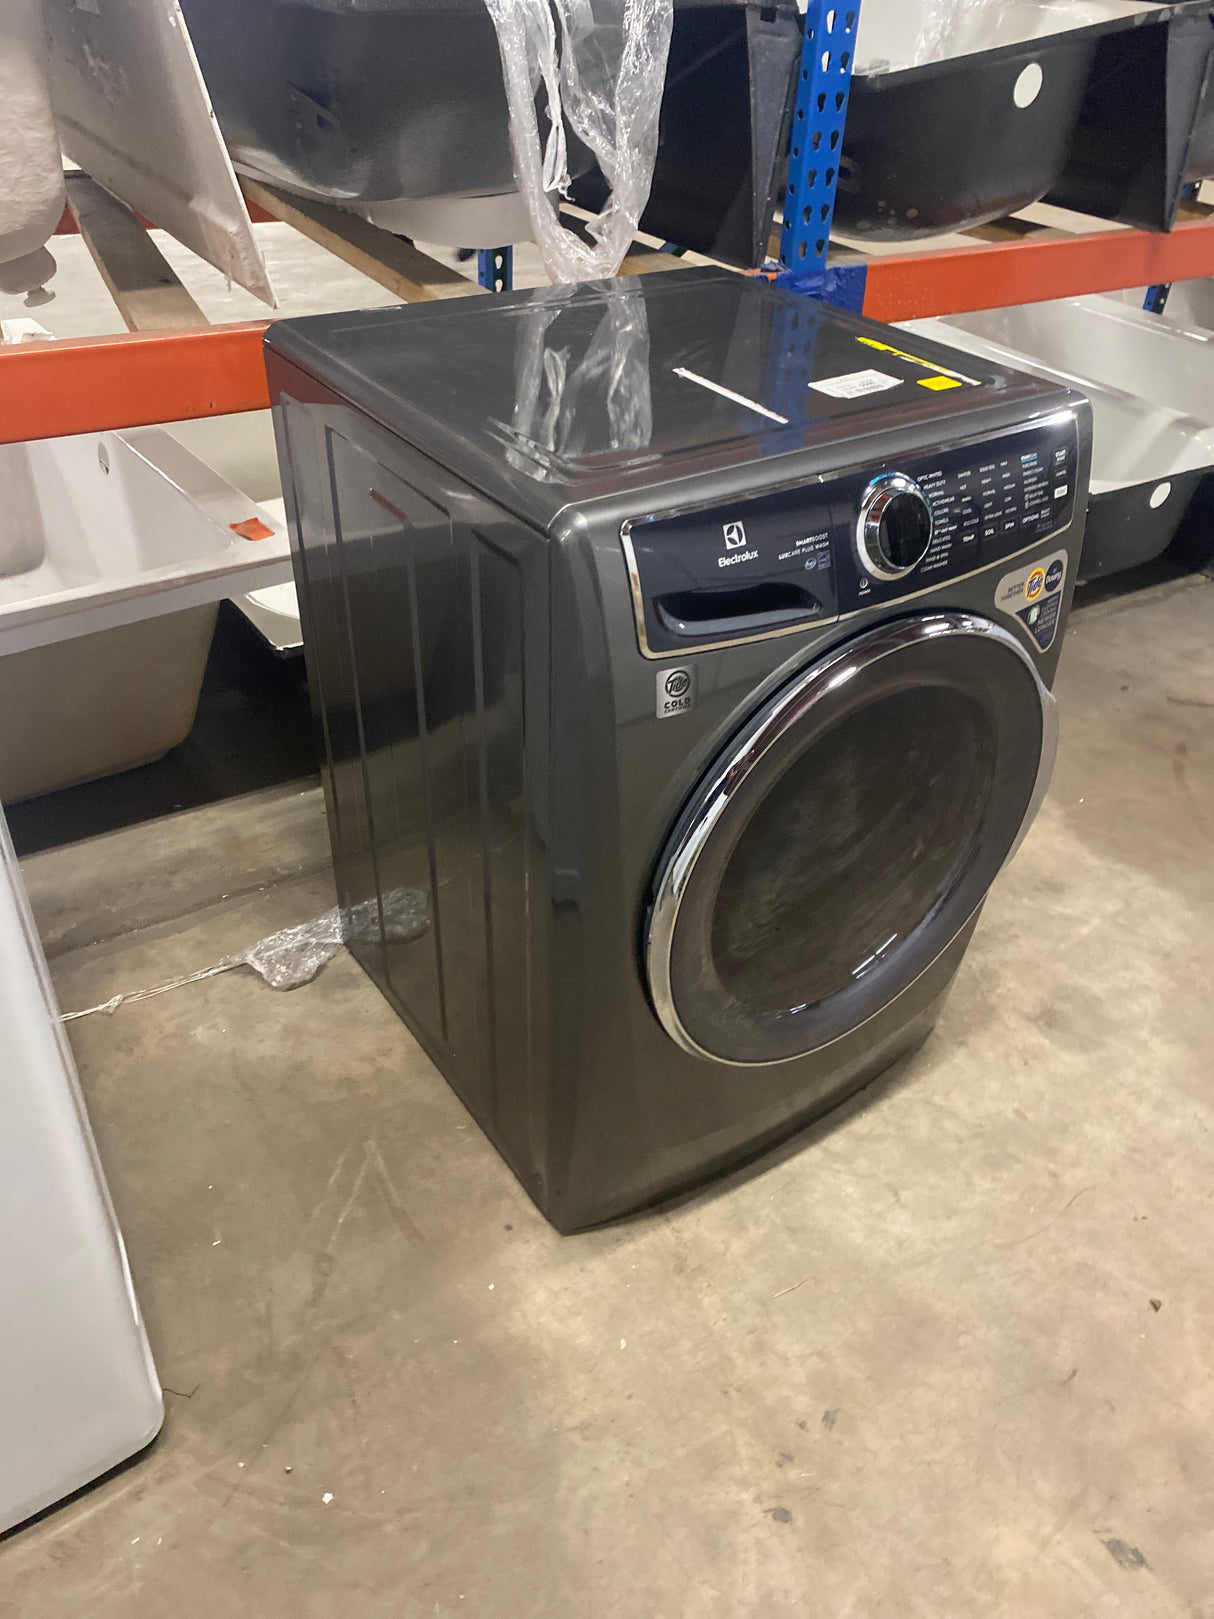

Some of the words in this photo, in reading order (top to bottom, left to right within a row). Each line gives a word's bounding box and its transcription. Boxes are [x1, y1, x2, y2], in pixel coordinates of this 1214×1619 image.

[1004, 521, 1015, 530] SPIN
[962, 534, 975, 543] TEMP
[801, 544, 814, 553] PLUS
[815, 541, 830, 550] WASH
[717, 550, 759, 568] Electrolux
[1045, 571, 1062, 585] Downy
[1007, 581, 1025, 593] BETTER
[1026, 575, 1044, 598] Tide
[667, 675, 689, 695] Tide
[664, 697, 691, 709] COLD
